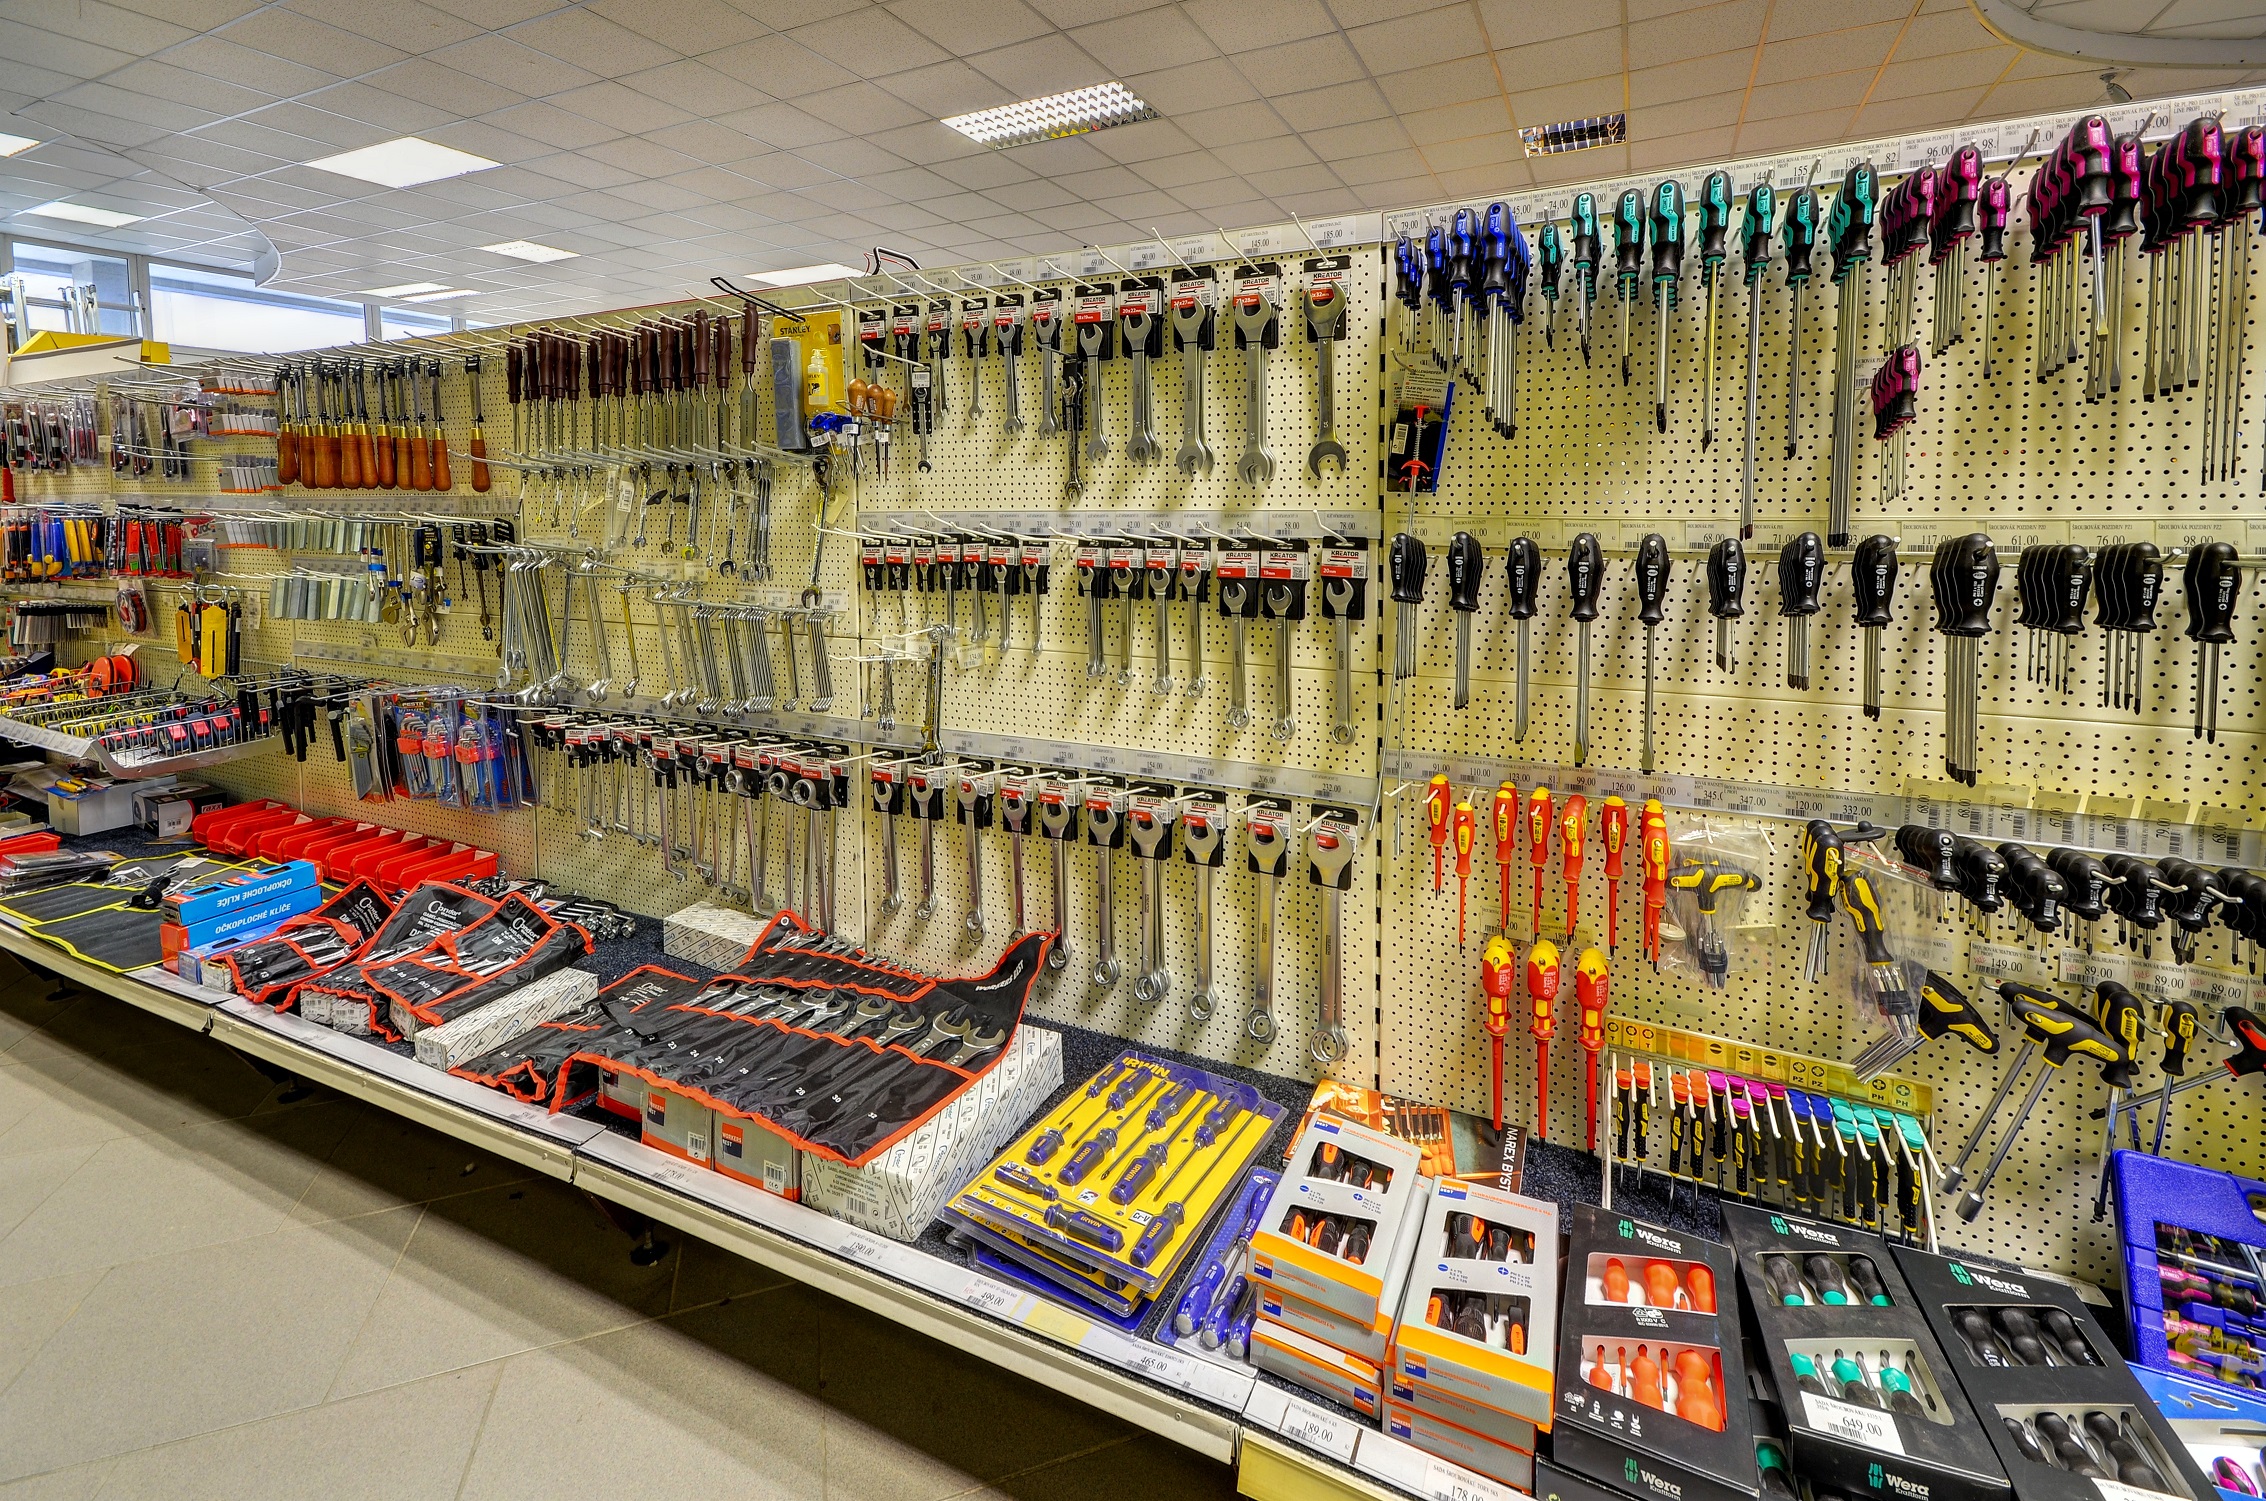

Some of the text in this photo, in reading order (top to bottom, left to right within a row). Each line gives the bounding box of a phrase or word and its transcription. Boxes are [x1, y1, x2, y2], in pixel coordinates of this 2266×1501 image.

[1927, 146, 1953, 158] 96.00
[1314, 271, 1342, 279] KREATOR
[780, 325, 811, 335] STANLEY
[1470, 528, 1487, 537] 81.00
[1522, 531, 1540, 540] 97.00
[1704, 533, 1725, 542] 68.00
[2011, 535, 2039, 545] 61.00
[2096, 536, 2125, 546] 76.00
[2184, 536, 2213, 546] 98.00
[1433, 764, 1450, 772] 91.00
[1470, 768, 1491, 777] 110.00
[1509, 773, 1531, 782] 123.00
[1576, 777, 1596, 786] 99.00
[1612, 782, 1635, 792] 126.00
[1652, 786, 1676, 796] 100.00
[1740, 796, 1766, 806] 347.00
[1795, 800, 1822, 812] 120.00
[1917, 794, 1930, 814] 68.00
[1257, 809, 1284, 818] KREATOR
[1843, 804, 1872, 816] 332.00
[1958, 798, 1971, 818] 68.00
[2001, 802, 2014, 822] 74.00
[2048, 807, 2063, 828] 67.00
[2102, 812, 2116, 833] 73.00
[1321, 820, 1350, 830] KREATOR
[2156, 818, 2171, 839] 79.00
[2213, 822, 2228, 844] 68.00
[217, 878, 292, 907] OČKOPLOCHÉ KLÍČE
[427, 900, 461, 916] Condor
[215, 903, 291, 934] OČKOPLOCHÉ KLÍČE
[512, 917, 540, 939] Condor
[1991, 959, 2022, 973] 149.00
[2084, 965, 2113, 978] 89.00
[2155, 975, 2184, 989] 89.00
[2211, 983, 2241, 998] 89.00
[668, 1041, 677, 1050] 23
[690, 1050, 699, 1058] 24
[1122, 1057, 1170, 1078] IRWIN
[795, 1087, 806, 1096] 28
[832, 1094, 841, 1103] 30
[722, 1132, 741, 1143] WORKERS
[1503, 1127, 1518, 1162] NAREX
[1074, 1146, 1092, 1164] IRWIN
[1124, 1164, 1142, 1182] IRWIN
[1080, 1215, 1102, 1227] IRWIN
[1133, 1212, 1151, 1222] Cr-V
[1147, 1221, 1163, 1239] IRWIN
[1789, 1224, 1838, 1242] Wera
[1636, 1228, 1682, 1250] Wera
[1970, 1272, 2027, 1294] Wera
[981, 1291, 1005, 1306] 499.00
[1140, 1355, 1167, 1372] 465.00
[1304, 1421, 1333, 1442] 189.00
[1842, 1417, 1882, 1437] 649.00
[1640, 1469, 1681, 1496] Wera
[1886, 1473, 1929, 1496] Wera
